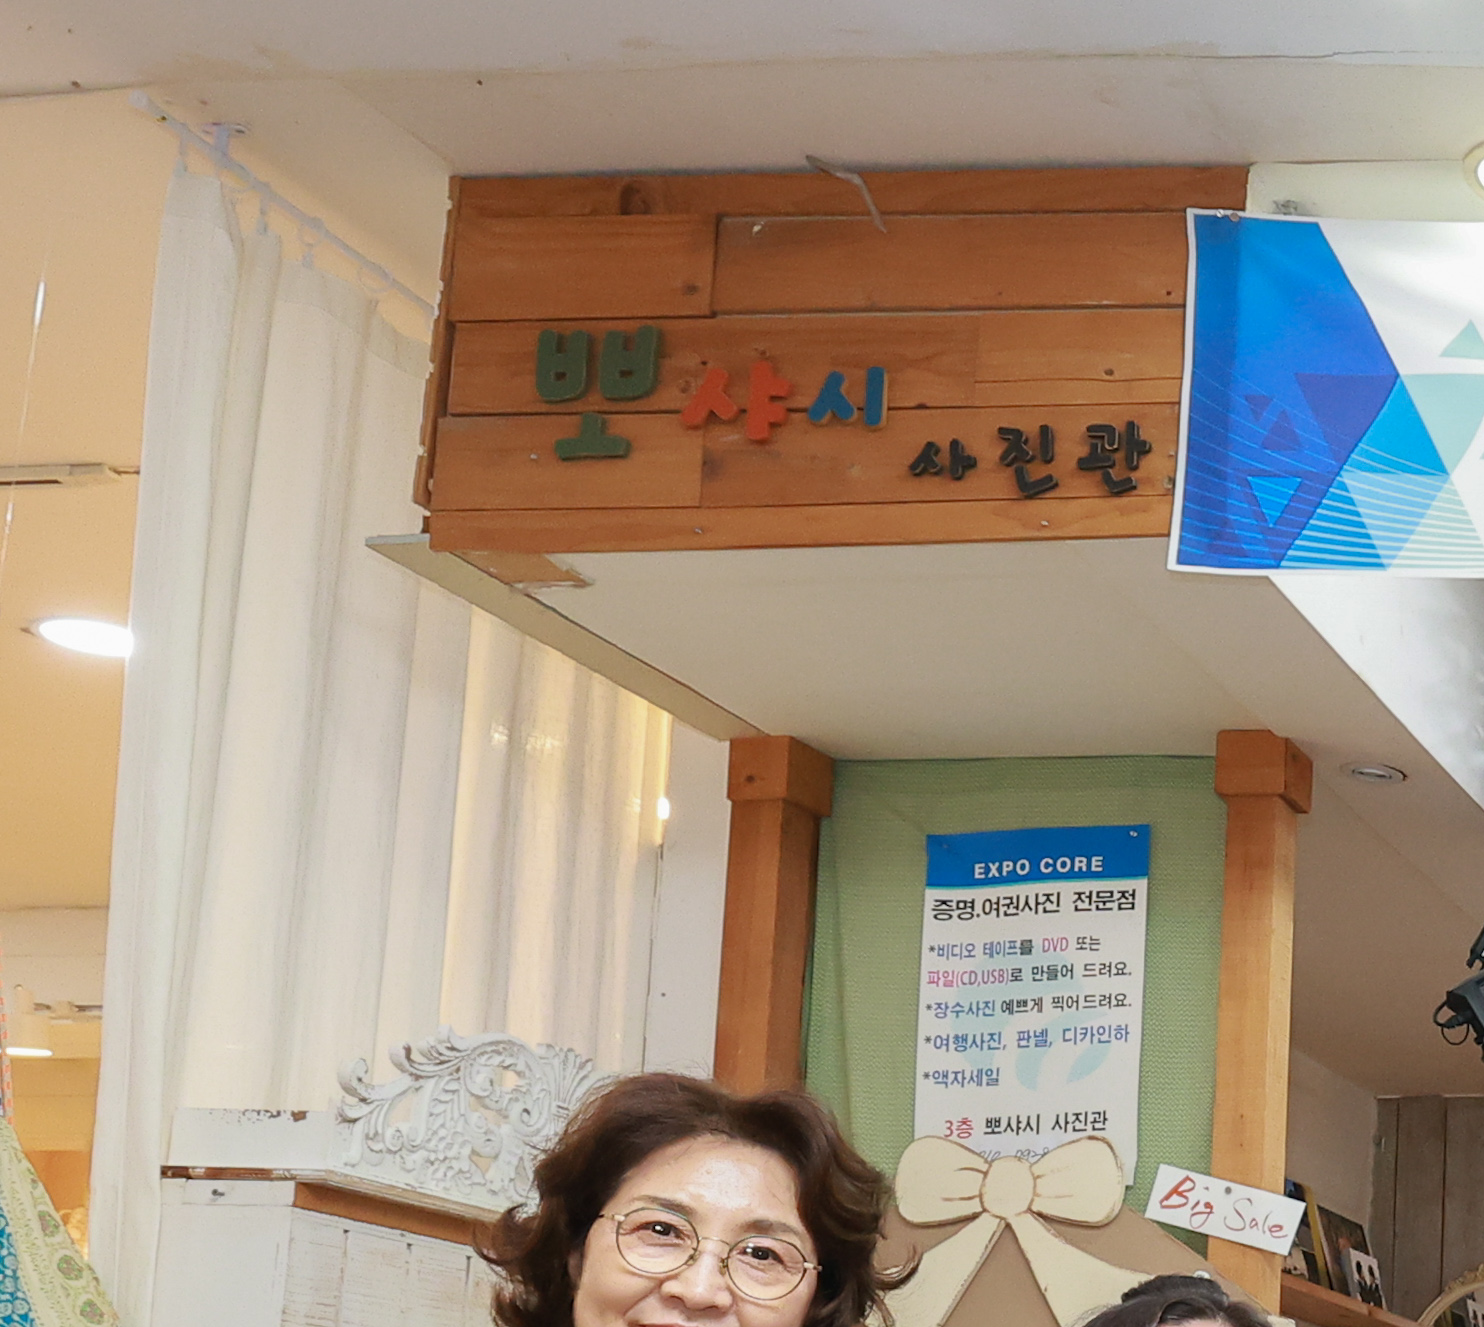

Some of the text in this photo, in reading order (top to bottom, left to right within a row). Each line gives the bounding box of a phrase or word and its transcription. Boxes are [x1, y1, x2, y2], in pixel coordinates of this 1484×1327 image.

[535, 324, 1152, 498] 뽀샤시 사진관
[974, 856, 1105, 880] EXPO CORE
[931, 889, 1137, 922] 증명.여권사진 전문점
[983, 939, 1034, 958] 테이프를
[1042, 937, 1070, 954] DVD
[1075, 936, 1101, 952] 또는
[926, 961, 1132, 988] 파일(CD,USB)로 만들어 드려요.
[1000, 997, 1044, 1017] 예쁘게
[1016, 1028, 1054, 1049] 판넬,
[1062, 1024, 1130, 1044] 디카인하
[943, 1110, 1108, 1139] 3층 뽀샤시 사진관
[1159, 1174, 1289, 1239] Big Sale
